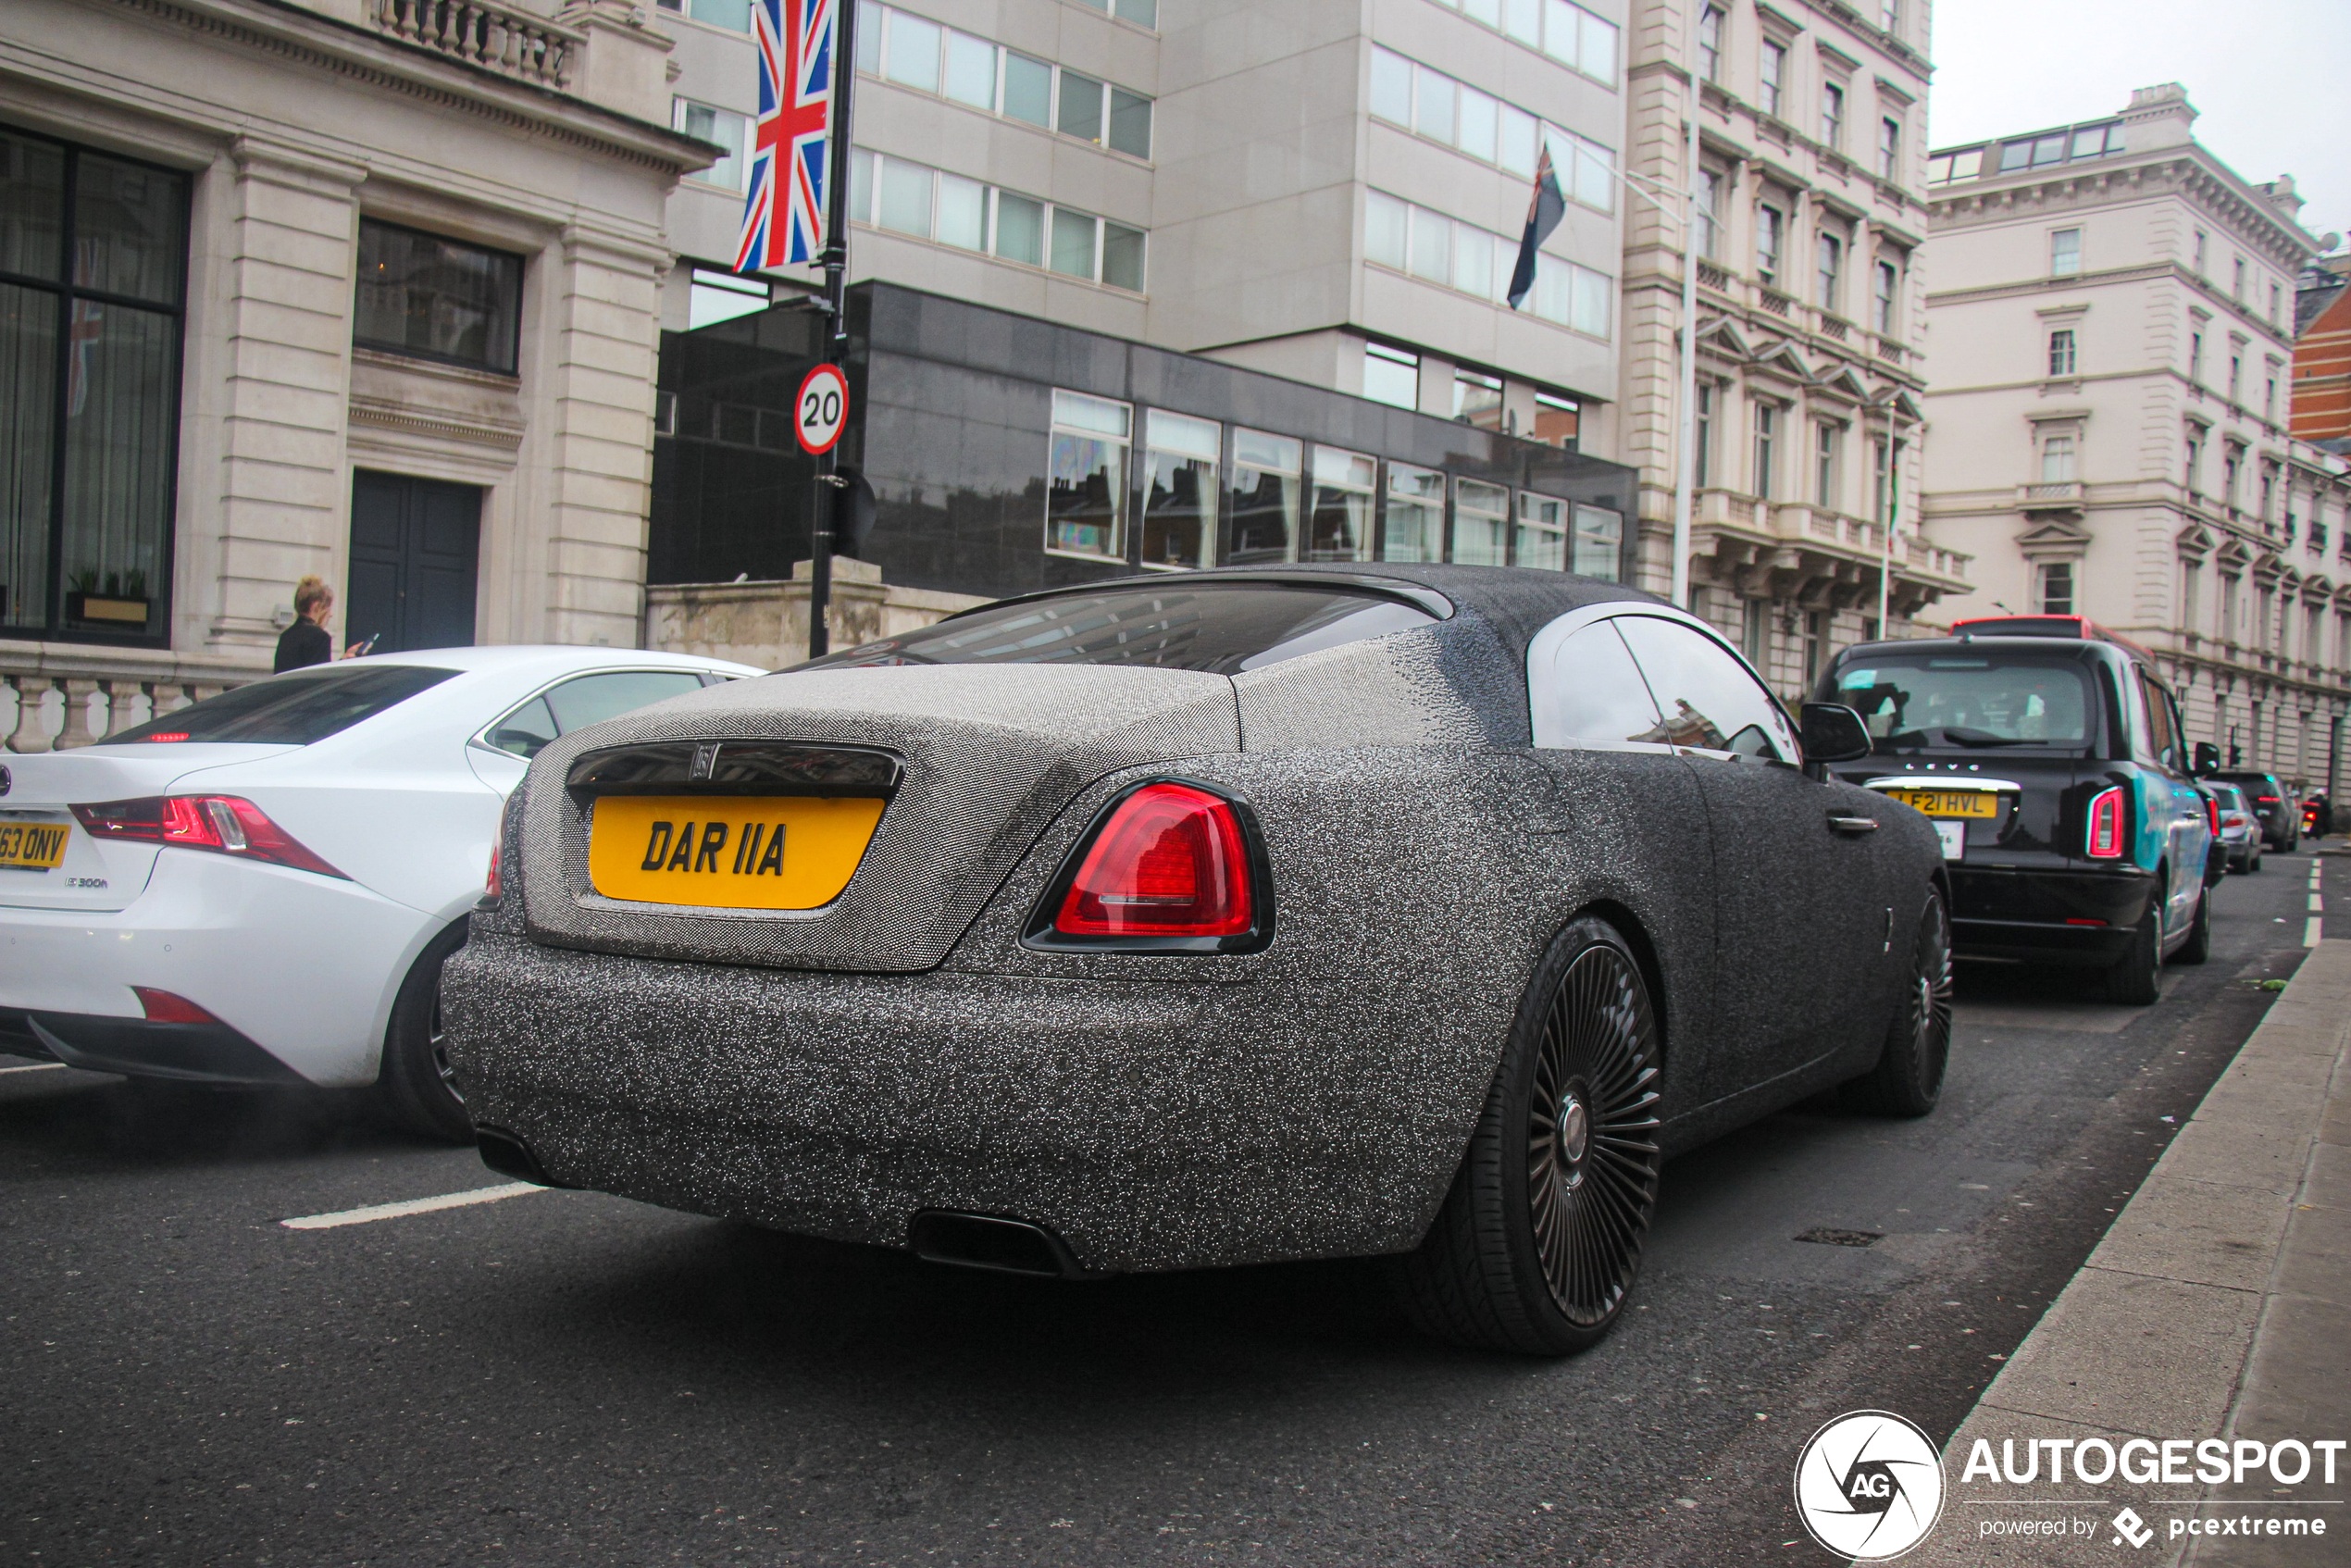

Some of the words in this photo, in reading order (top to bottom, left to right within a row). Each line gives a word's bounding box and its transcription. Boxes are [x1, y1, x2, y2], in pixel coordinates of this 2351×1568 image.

[803, 391, 840, 428] 20
[1905, 763, 1980, 771] LEVC
[1947, 794, 1984, 814] HVL
[0, 827, 23, 859] 63
[23, 828, 65, 862] ONV
[641, 821, 729, 874] DAR
[78, 877, 108, 889] 300h
